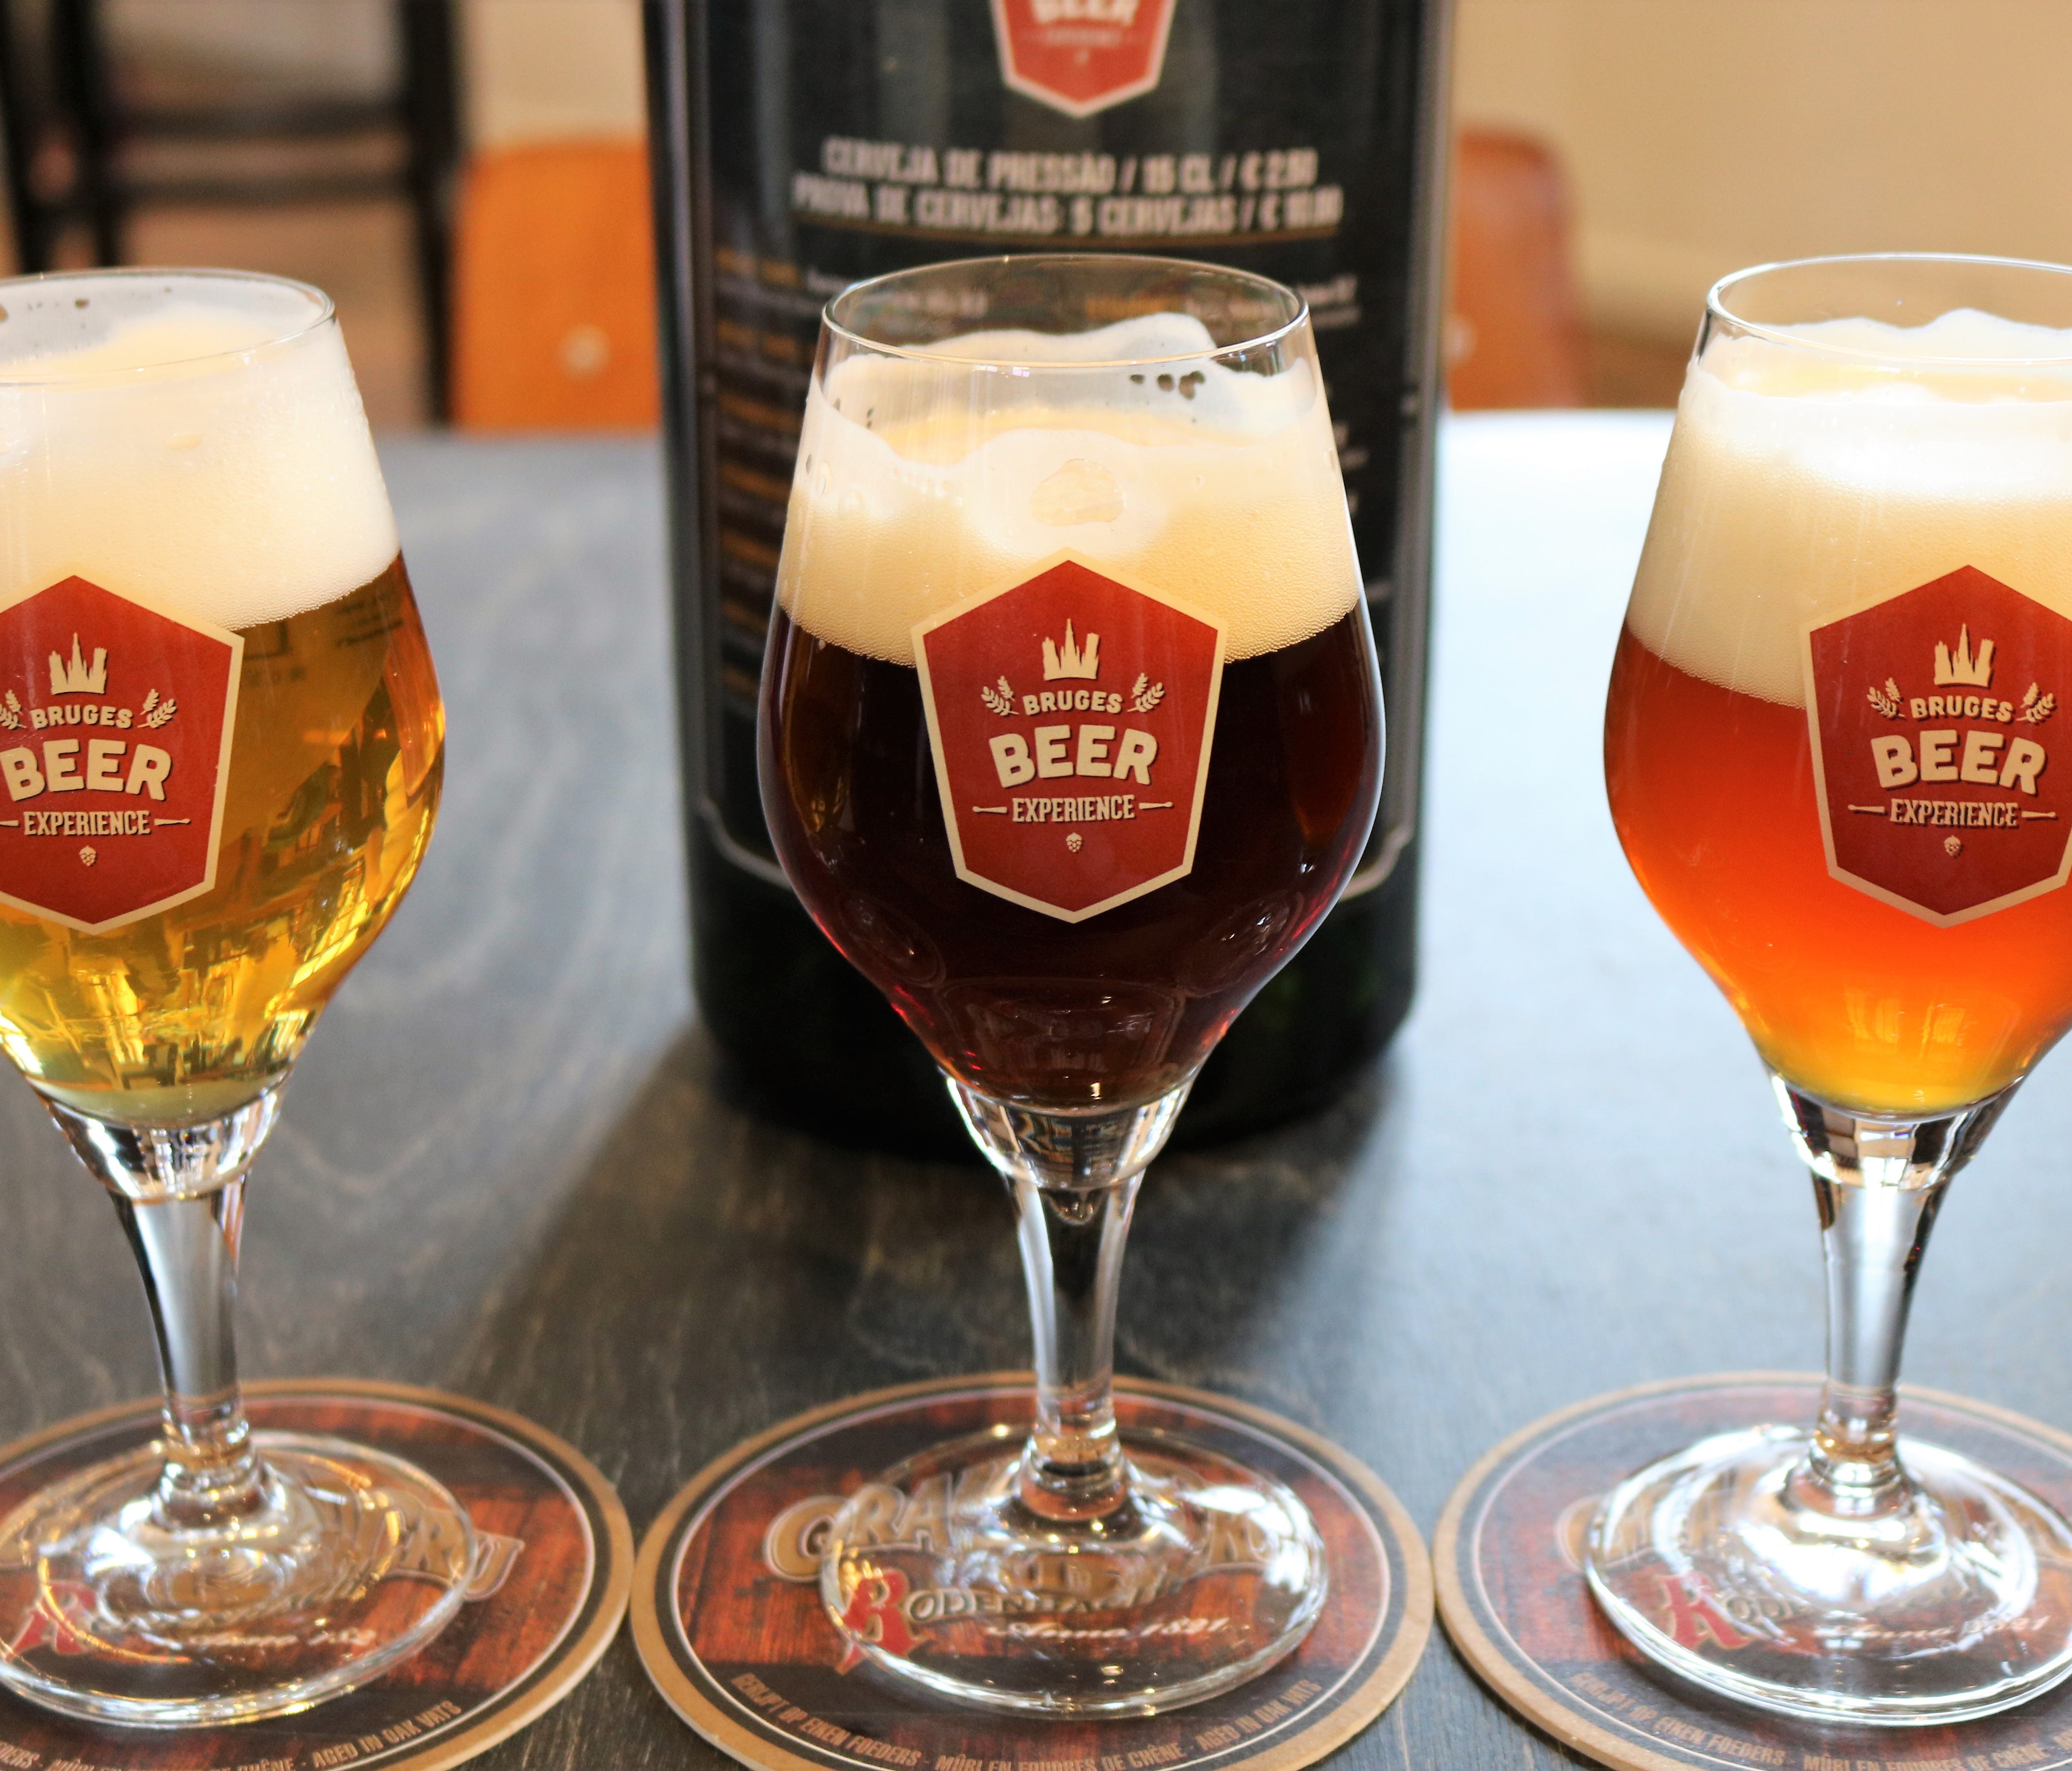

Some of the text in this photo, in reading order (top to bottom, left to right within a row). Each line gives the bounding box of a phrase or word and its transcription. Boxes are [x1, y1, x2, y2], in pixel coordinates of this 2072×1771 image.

[31, 705, 133, 729] BRUGES
[1023, 690, 1123, 715] BRUGES
[1910, 696, 2014, 723] BRUGES
[0, 739, 172, 801] BEER
[988, 724, 1158, 788] BEER
[1871, 729, 2046, 795] BEER
[24, 811, 151, 836] EXPERIENCE
[1013, 795, 1135, 822] EXPERIENCE
[1890, 798, 2019, 827] EXPERIENCE
[311, 1742, 359, 1768] AGED
[359, 1734, 384, 1754] IN
[381, 1719, 422, 1744] OAK
[415, 1700, 462, 1728] VATS
[800, 1717, 851, 1746] EIKEN
[846, 1735, 922, 1767] FOEDERS
[1101, 1754, 1125, 1771] DE
[1127, 1742, 1187, 1768] CHÊNE
[1195, 1725, 1241, 1751] AGED
[1235, 1716, 1263, 1733] IN
[1254, 1699, 1293, 1723] OAK
[1280, 1679, 1322, 1705] VATS
[1707, 1733, 1787, 1767] FOEDERS
